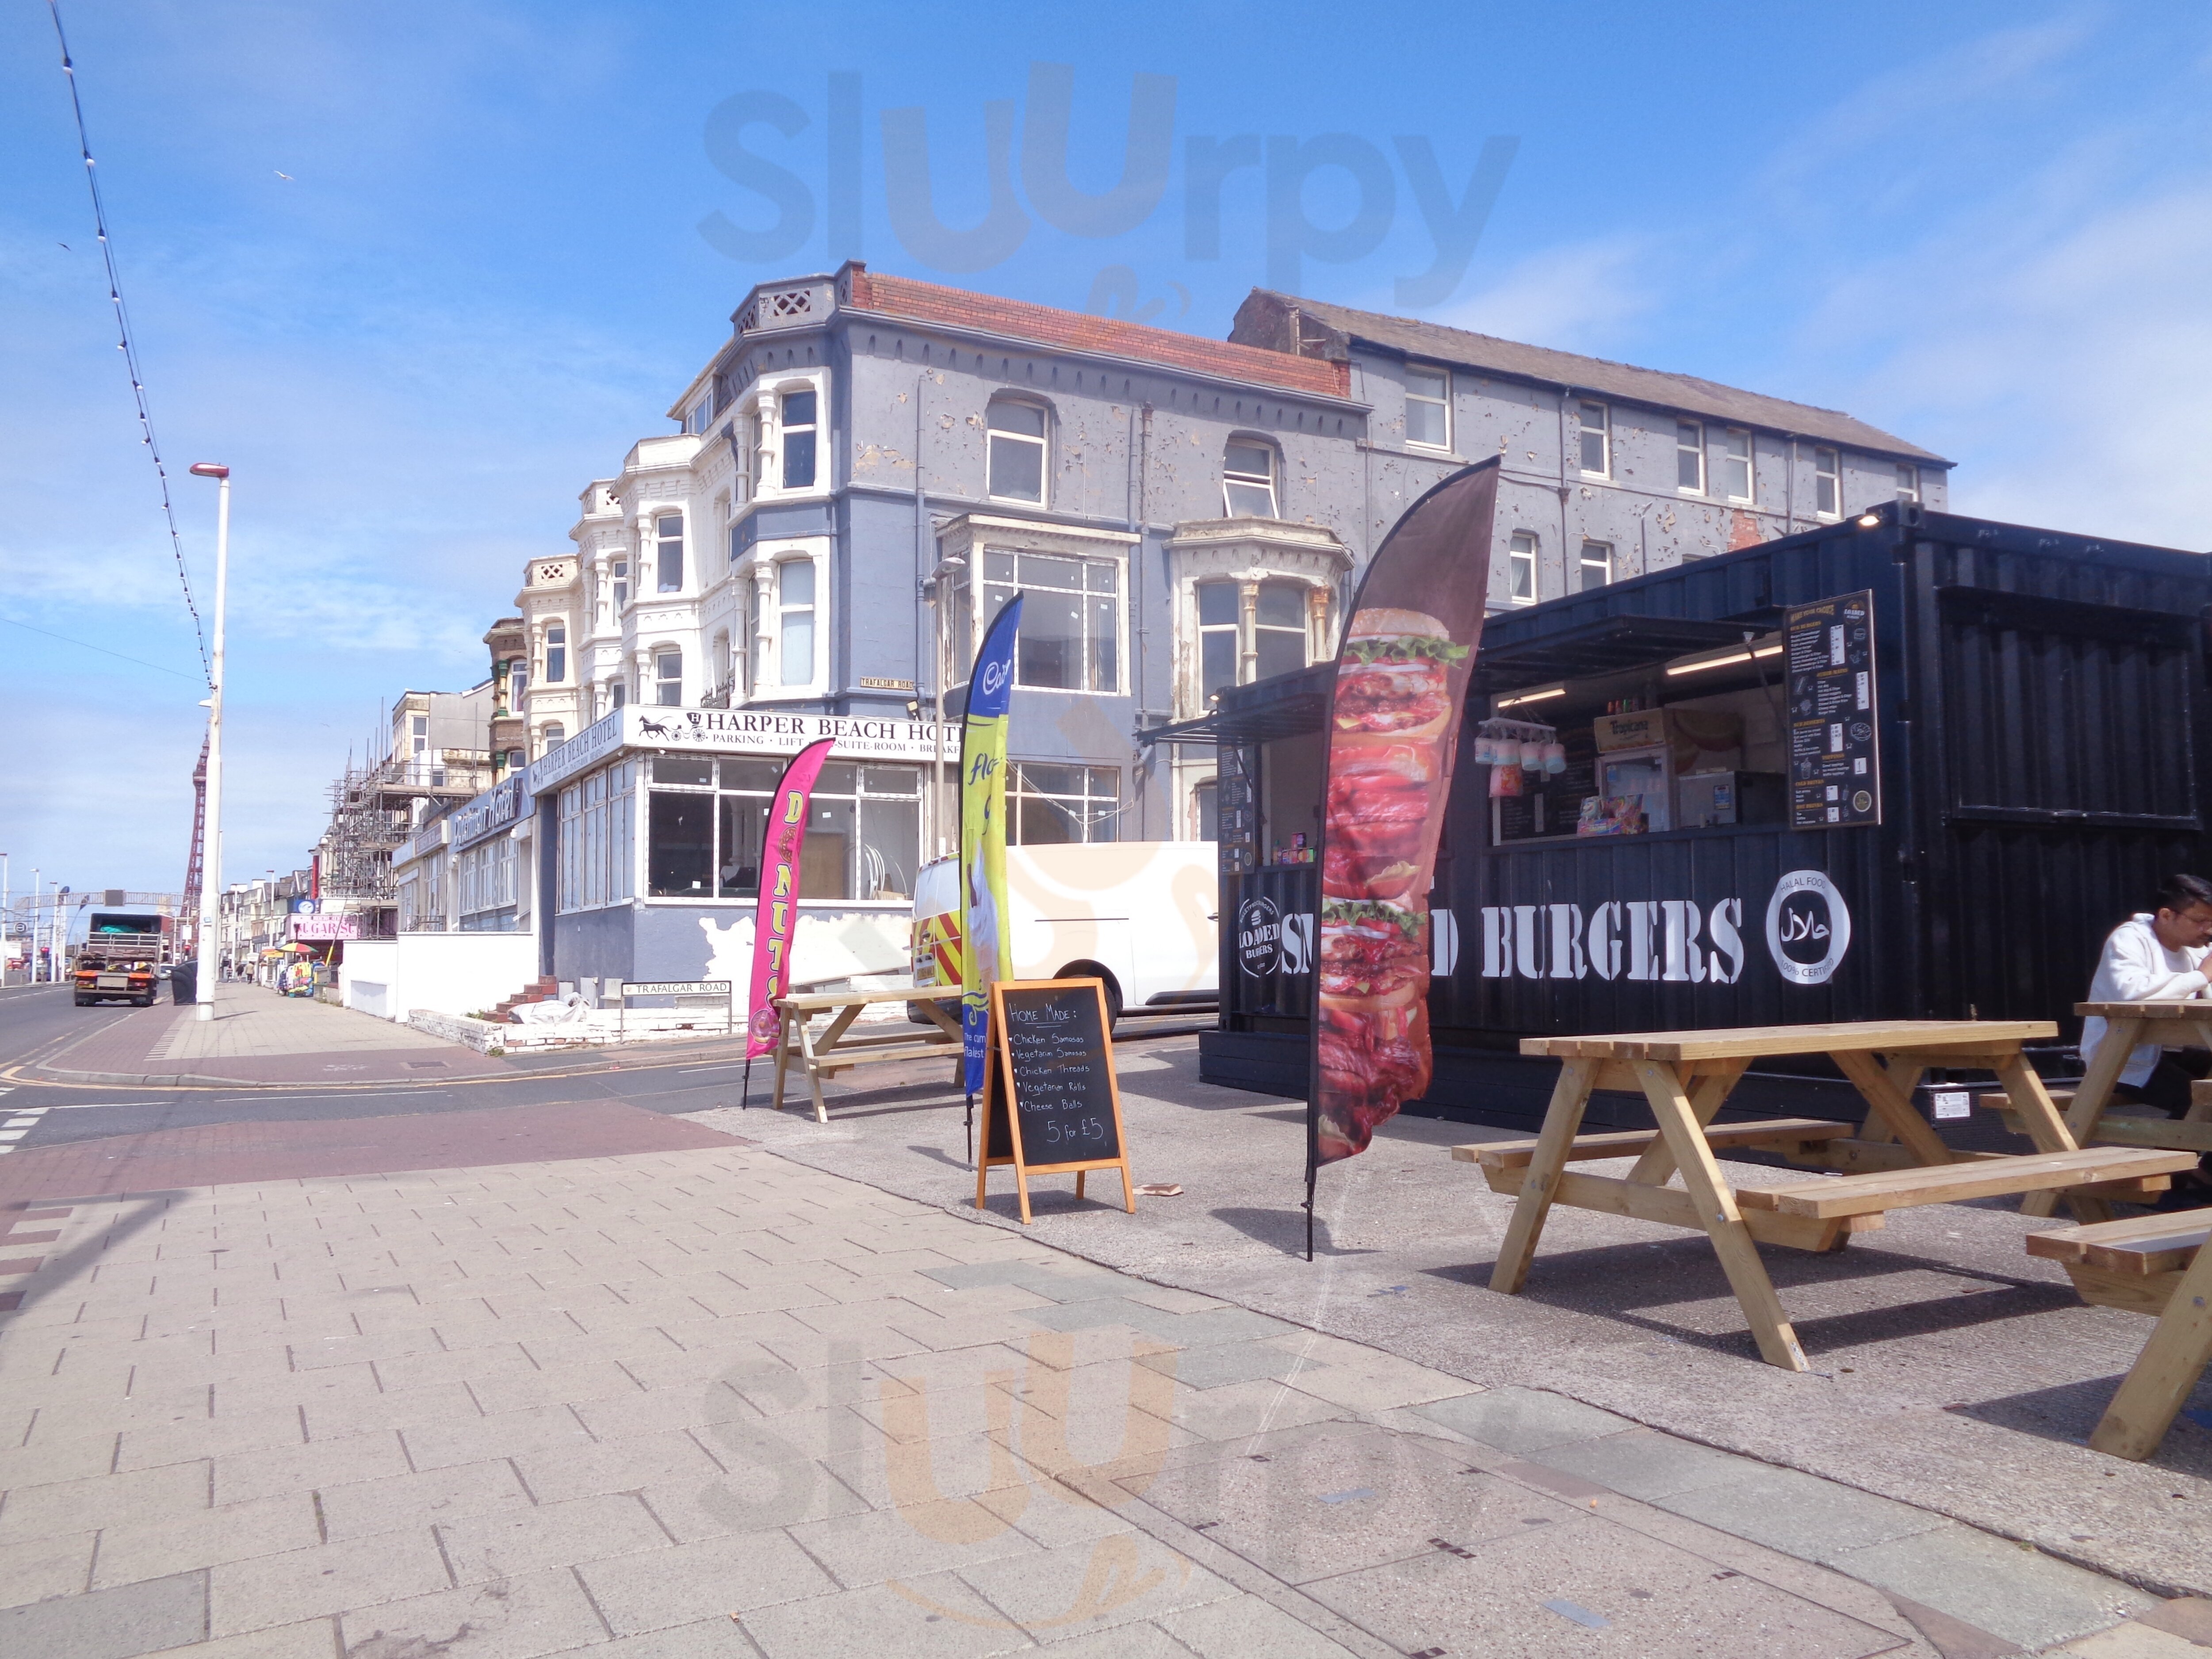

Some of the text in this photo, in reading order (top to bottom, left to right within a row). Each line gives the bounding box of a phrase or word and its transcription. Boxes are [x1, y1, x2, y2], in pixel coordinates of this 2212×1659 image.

[862, 679, 894, 687] TRAFALGAR
[706, 713, 961, 742] HARPER BEACH HOT
[543, 746, 565, 776] HARPER
[568, 731, 589, 763] BEACH
[592, 715, 617, 749] HOTEL
[713, 734, 764, 744] PARKING
[779, 738, 804, 746] LIFT
[832, 740, 906, 751] -SUITE-ROOM
[1780, 877, 1805, 893] HALAL
[1481, 898, 1744, 984] BURGERS
[636, 983, 727, 993] TRAFALGAR ROAD
[1057, 1064, 1090, 1073] Threads
[1069, 1082, 1086, 1091] Rolls
[1062, 1099, 1083, 1110] Balls
[1046, 1117, 1104, 1143] 5 for £5
